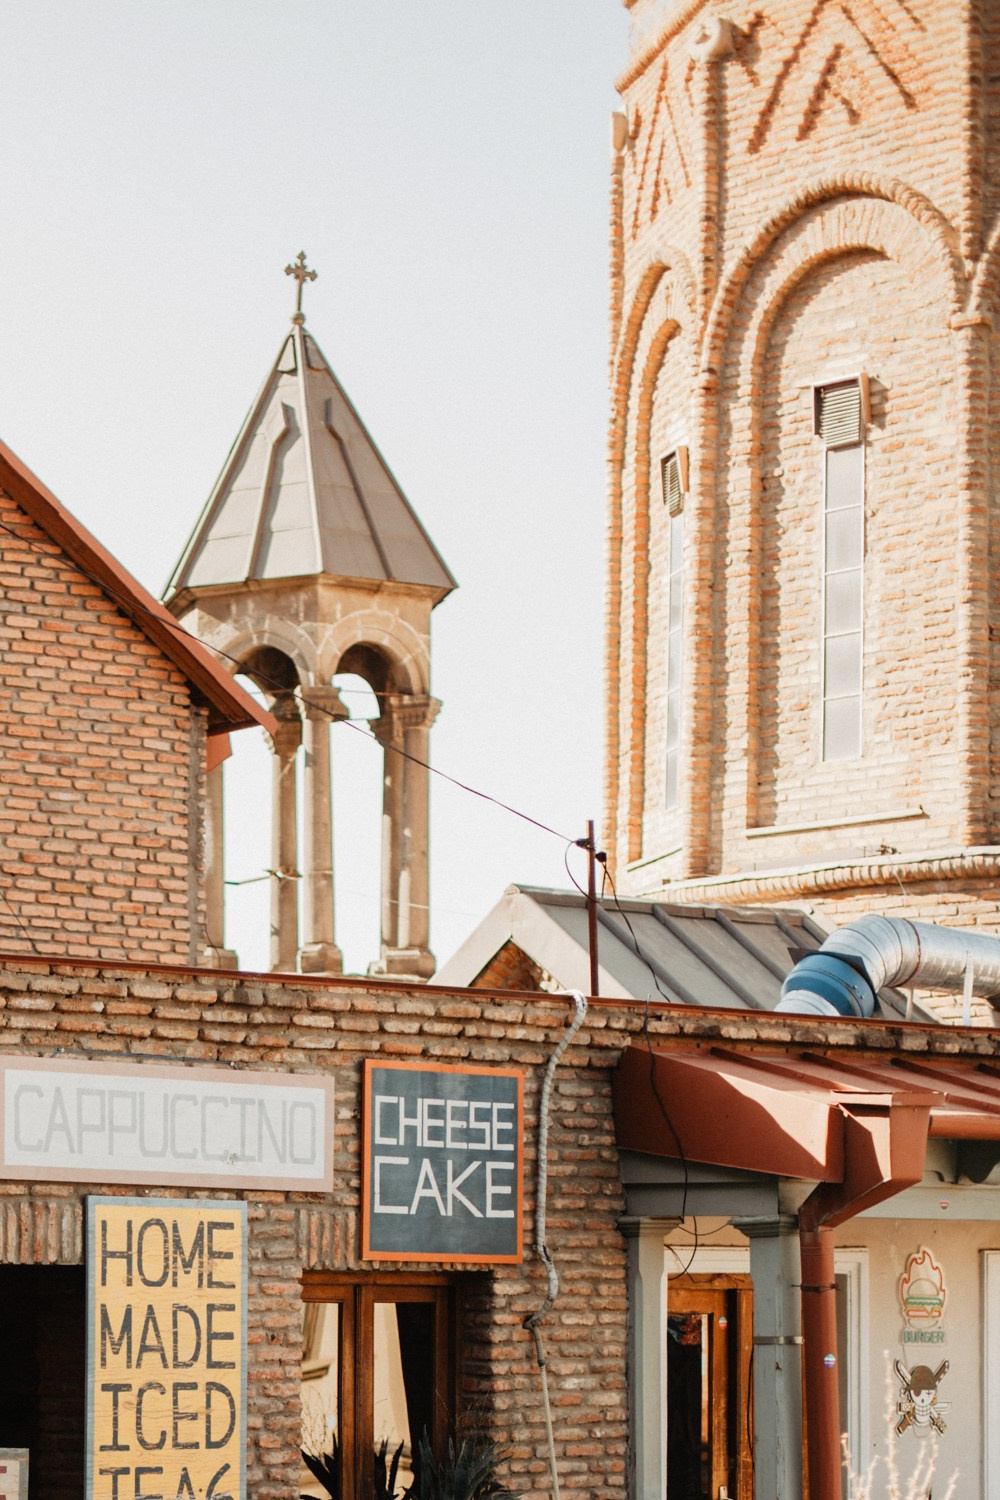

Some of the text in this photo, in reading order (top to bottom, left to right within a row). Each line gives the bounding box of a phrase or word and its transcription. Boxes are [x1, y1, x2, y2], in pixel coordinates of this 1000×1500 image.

[13, 1084, 317, 1165] CAPPUCCINO
[374, 1095, 515, 1151] CHEESE
[374, 1155, 515, 1218] CAKE
[101, 1218, 236, 1289] HOME
[100, 1303, 236, 1369] MADE
[903, 1330, 945, 1344] BURGER
[99, 1381, 236, 1451] ICED
